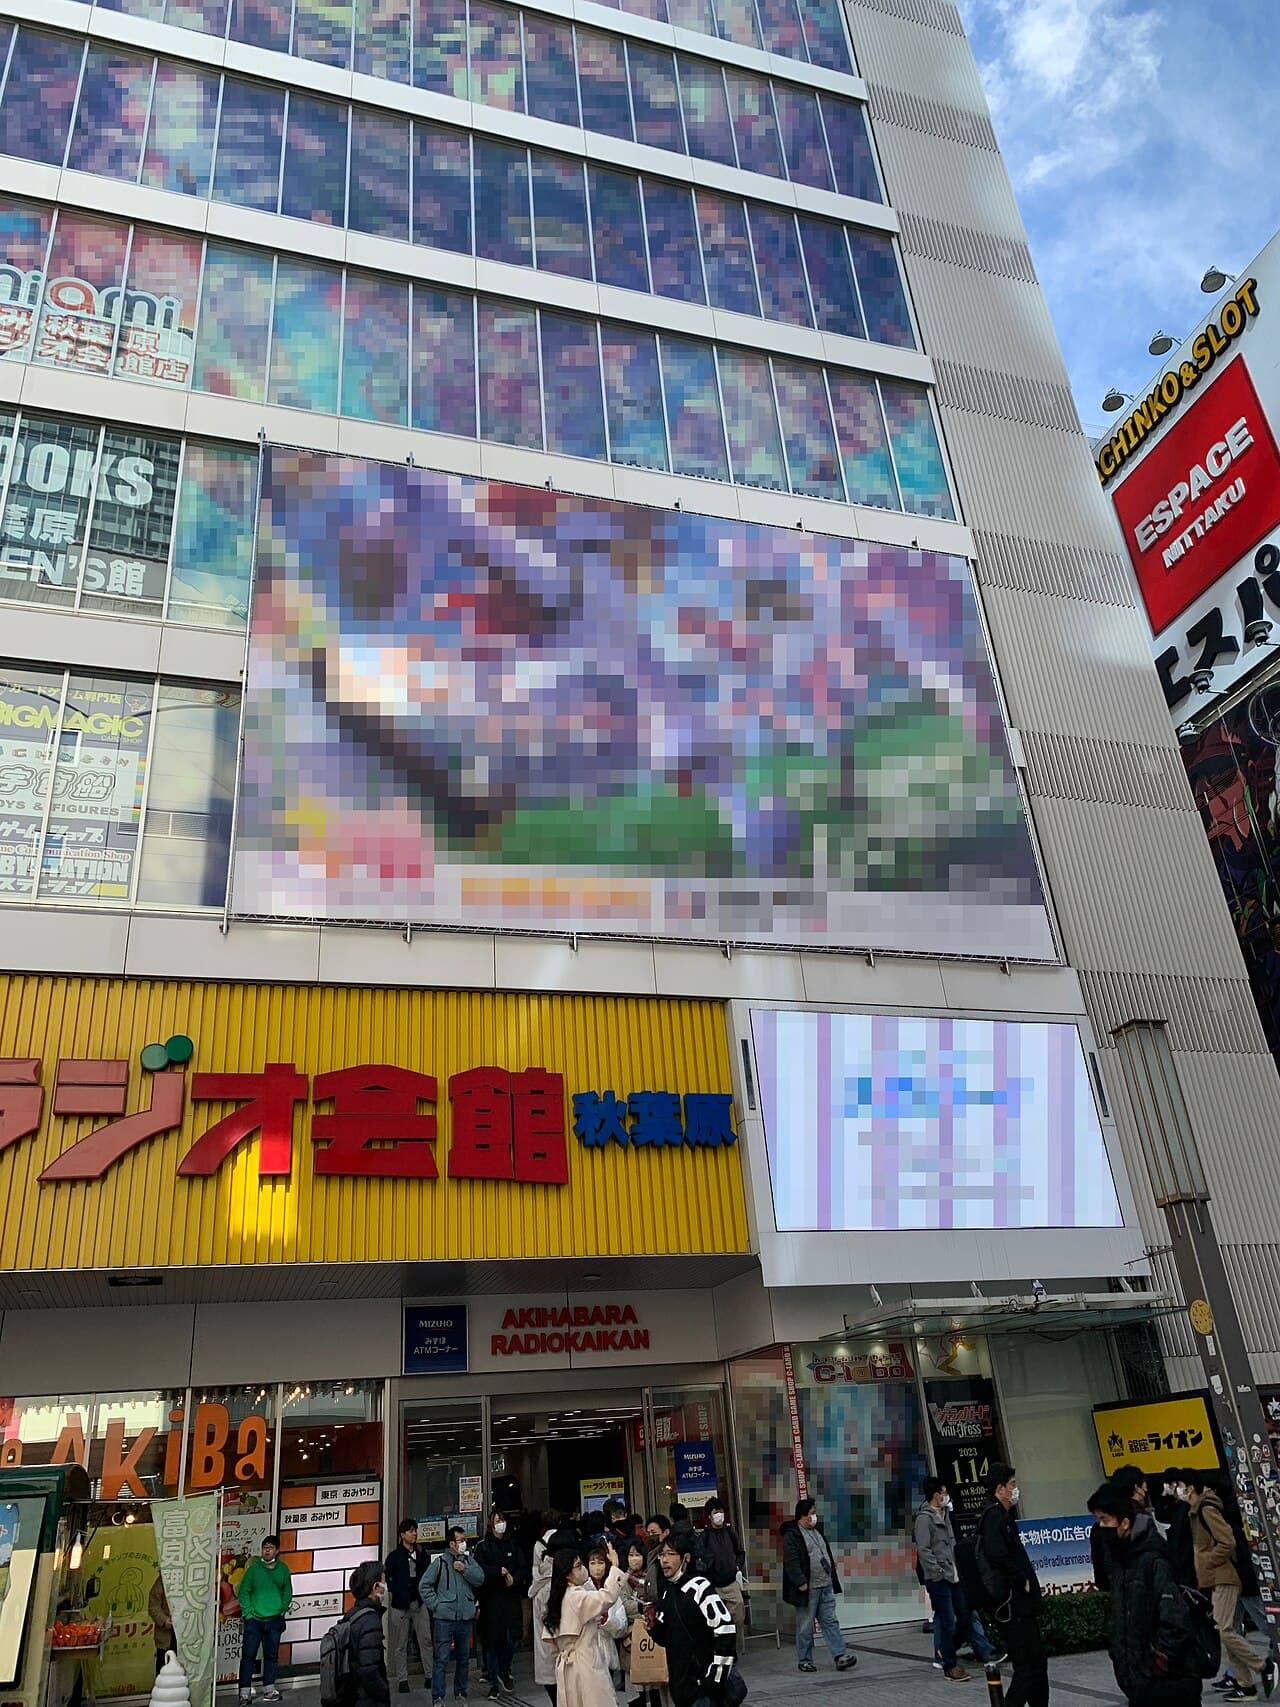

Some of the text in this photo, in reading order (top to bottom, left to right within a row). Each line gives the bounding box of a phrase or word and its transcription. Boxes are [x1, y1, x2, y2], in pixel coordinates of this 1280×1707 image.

[1134, 416, 1254, 552] ESPACE
[1161, 476, 1246, 569] NITTAKU
[33, 803, 43, 811] &
[52, 803, 119, 816] FIGURES
[104, 850, 130, 862] Shop
[571, 1090, 737, 1149] 秋葉原
[501, 1304, 638, 1330] AKIHABARA
[419, 1319, 453, 1328] MIZUHO
[425, 1336, 446, 1346] みずほ
[491, 1328, 650, 1357] RADIOKAIKAN
[413, 1346, 459, 1356] ATMコーナー
[1128, 1429, 1203, 1453] 銀座ライオン
[959, 1448, 977, 1456] 2023
[321, 1487, 375, 1499] 東京 おみやげ
[310, 1510, 339, 1522] おみやげ
[219, 1527, 266, 1539] ロンラスク
[640, 1638, 655, 1652] GU
